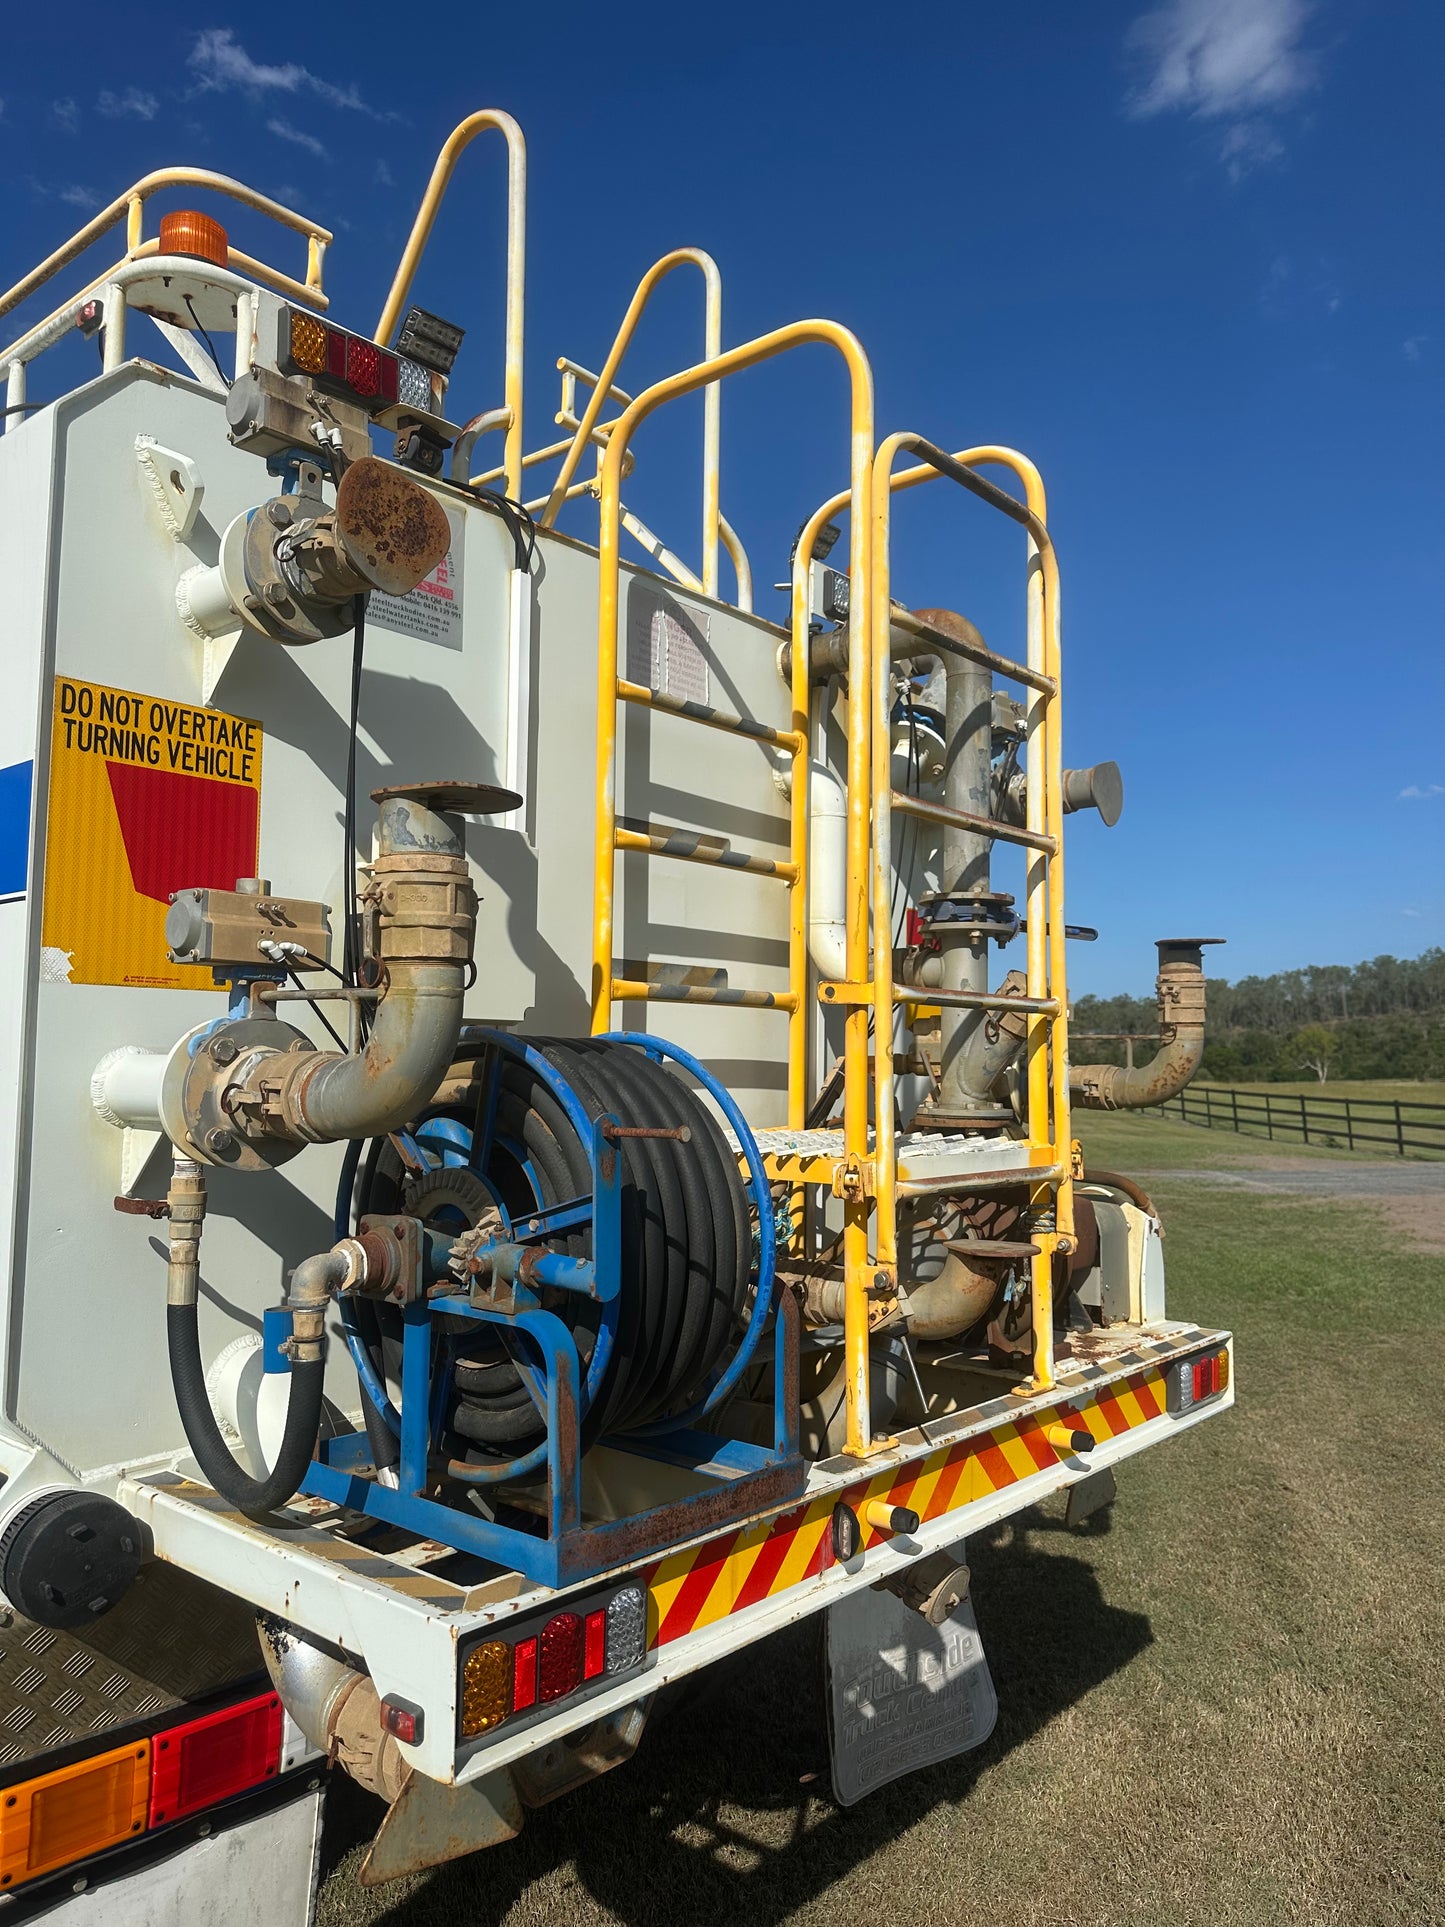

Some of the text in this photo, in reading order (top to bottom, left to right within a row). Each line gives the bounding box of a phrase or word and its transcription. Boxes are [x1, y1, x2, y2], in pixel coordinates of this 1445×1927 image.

[436, 559, 448, 583] EEL
[417, 592, 429, 601] Park
[423, 602, 438, 612] 0416
[61, 683, 257, 752] DO NOT OVERTAKE
[63, 718, 254, 782] TURNING VEHICLE
[842, 1701, 900, 1748] Truck
